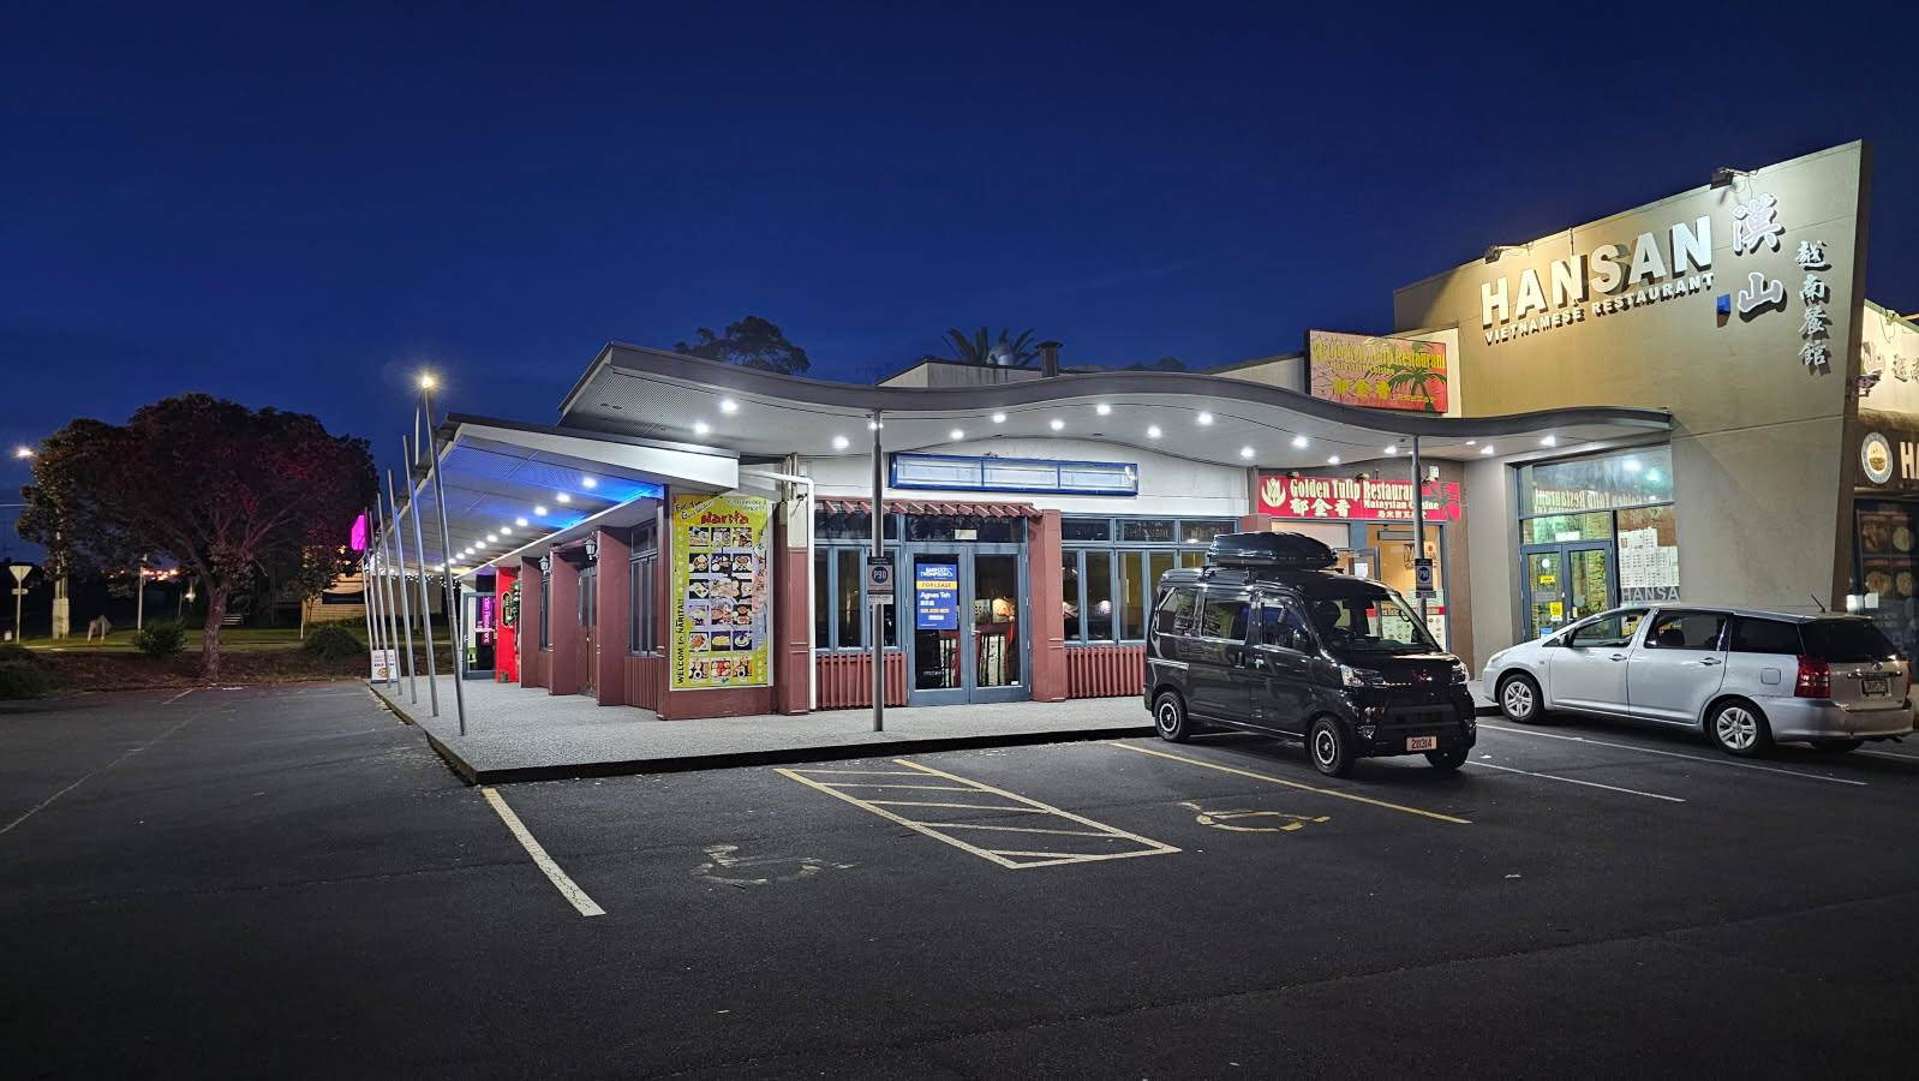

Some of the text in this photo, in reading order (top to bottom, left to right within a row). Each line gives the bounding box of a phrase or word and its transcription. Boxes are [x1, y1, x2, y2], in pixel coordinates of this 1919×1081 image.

[1481, 215, 1712, 327] HANSAN
[1485, 272, 1715, 345] VIETNAMESE RESTAURANT
[1396, 350, 1446, 370] Restaurant
[1290, 478, 1330, 498] Golden
[1332, 479, 1360, 501] Tulip
